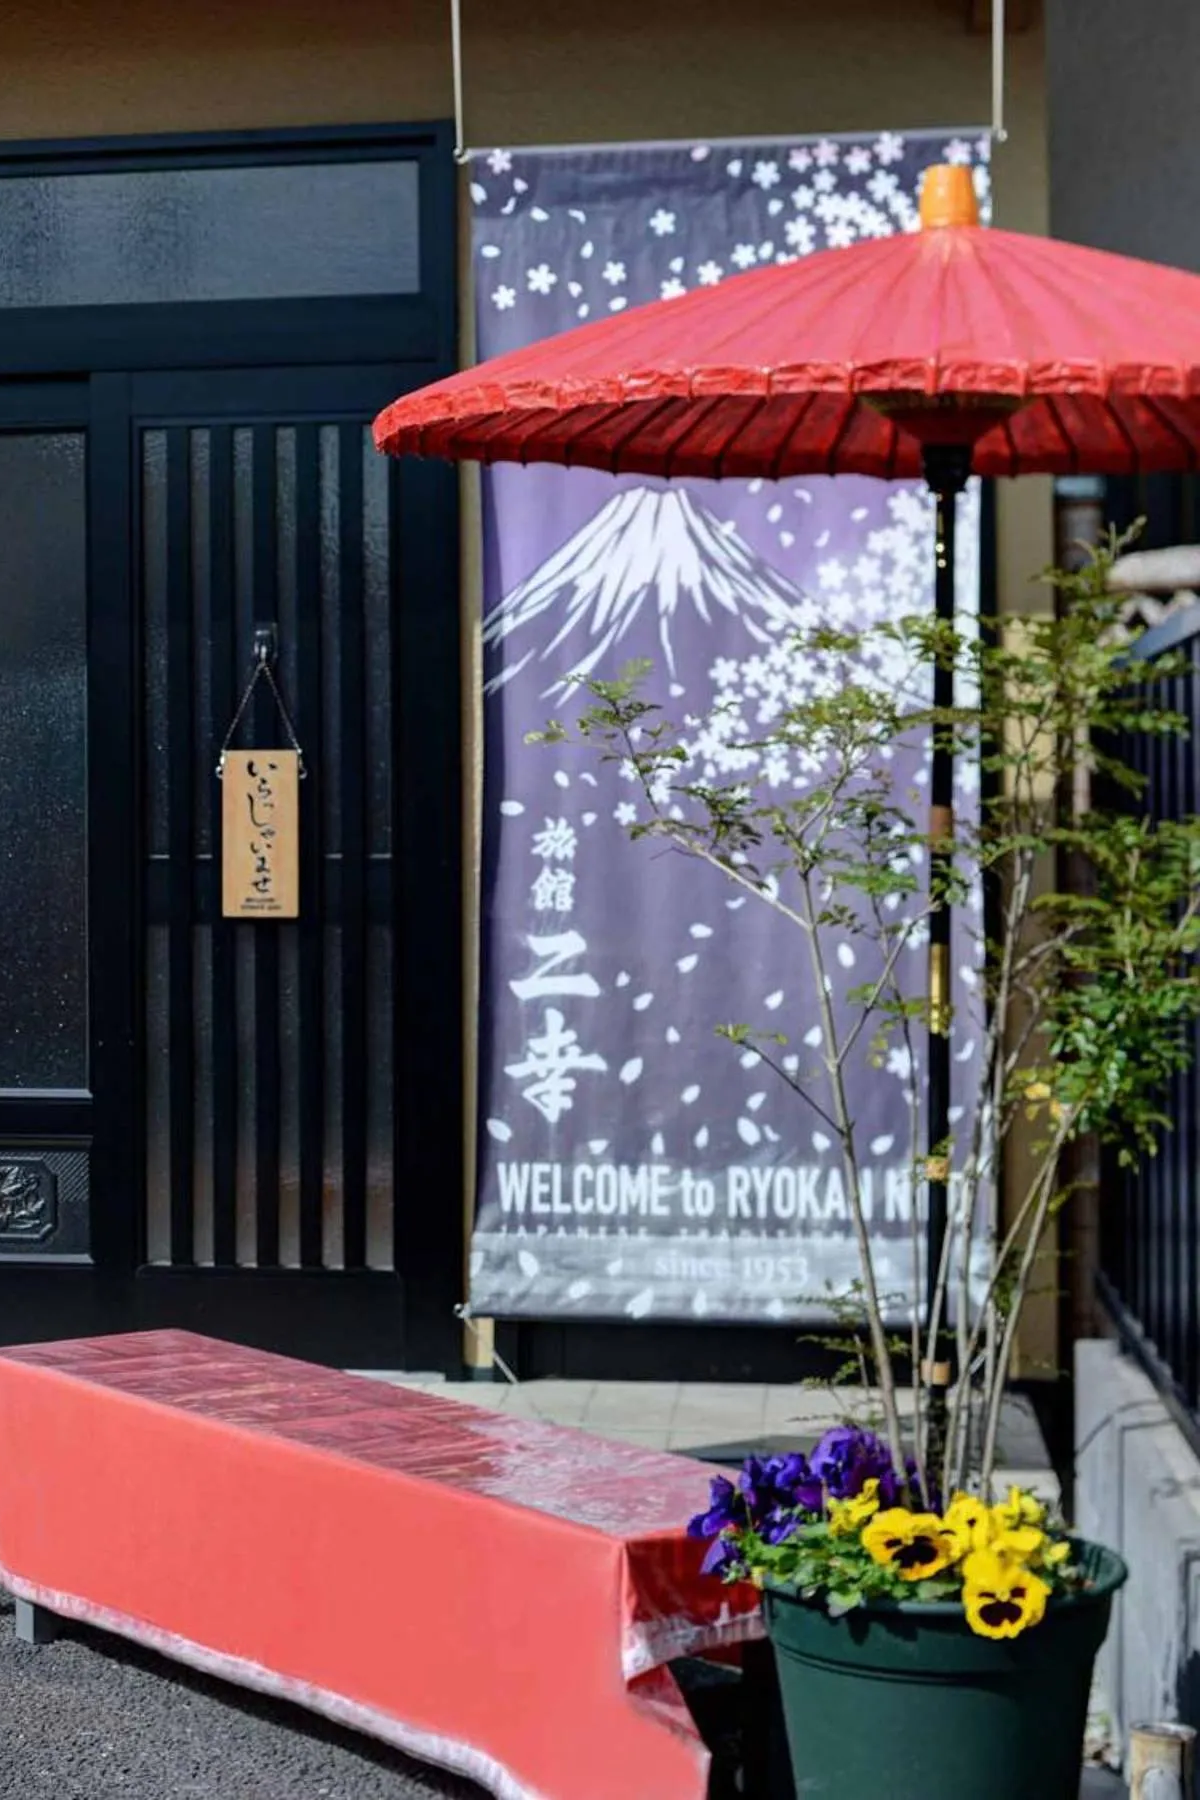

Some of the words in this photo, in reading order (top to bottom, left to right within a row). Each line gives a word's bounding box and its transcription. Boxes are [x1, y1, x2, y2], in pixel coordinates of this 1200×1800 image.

[246, 759, 278, 893] いらっしゃいませ
[497, 1162, 671, 1216] WELCOME
[680, 1167, 715, 1218] to
[727, 1165, 873, 1221] RYOKAN
